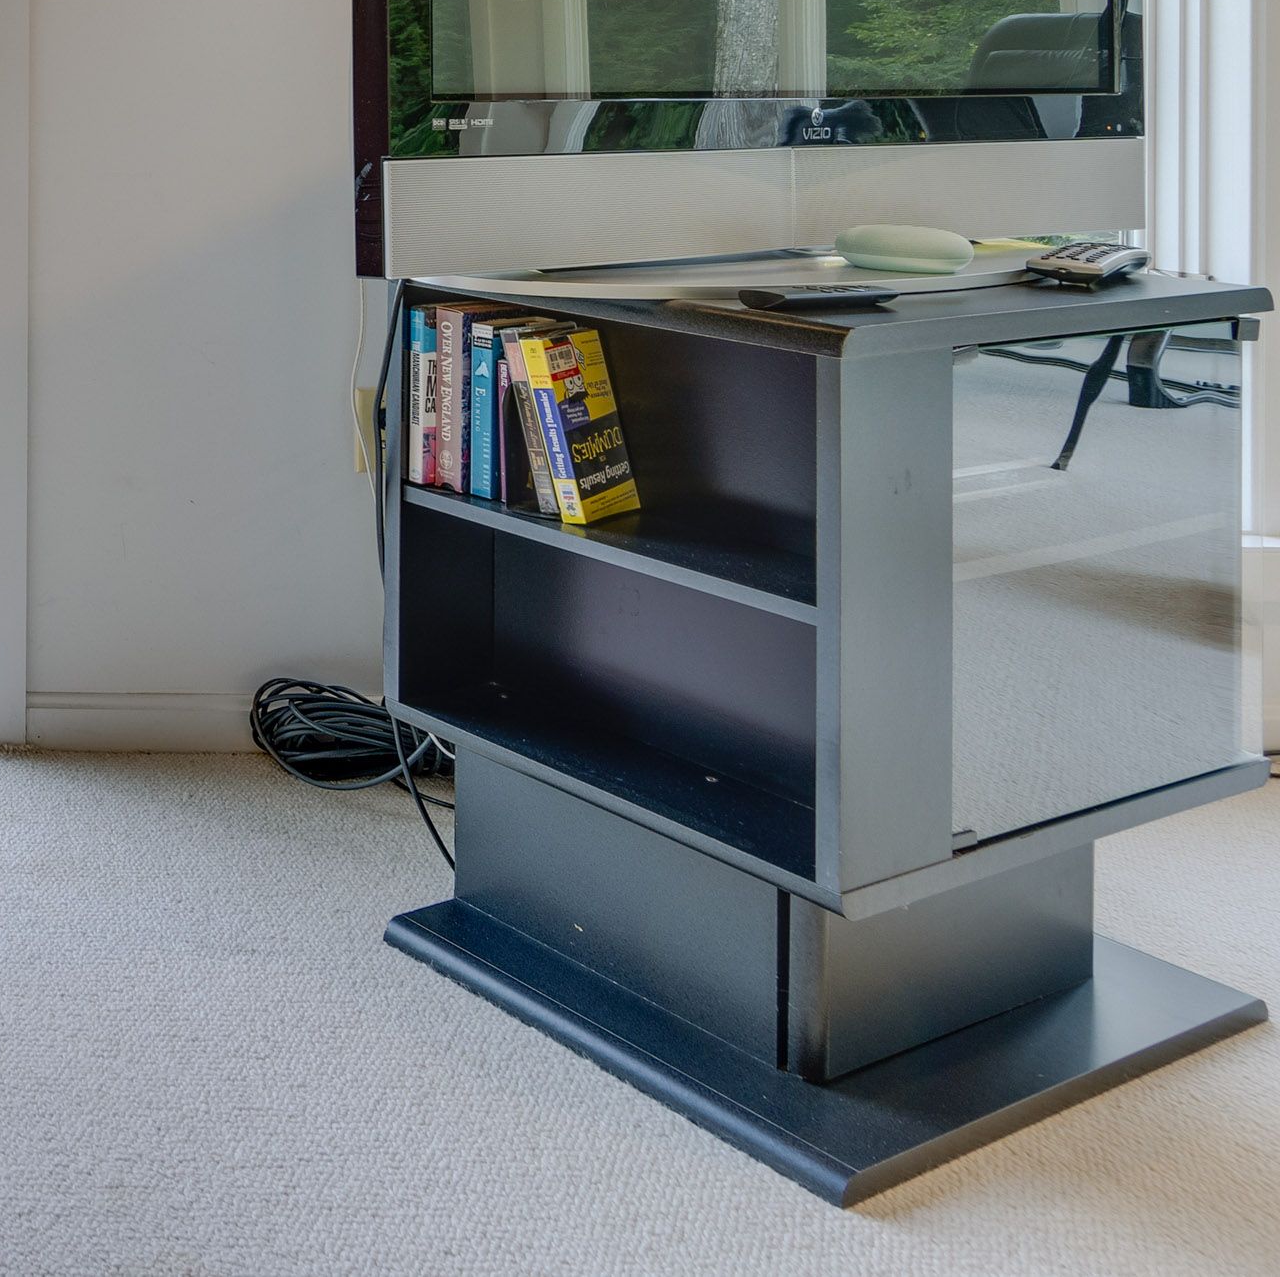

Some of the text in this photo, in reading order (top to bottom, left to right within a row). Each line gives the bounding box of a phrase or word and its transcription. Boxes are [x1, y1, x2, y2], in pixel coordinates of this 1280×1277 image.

[802, 127, 831, 140] VIZIO
[411, 352, 421, 392] MANCHURIAN
[440, 321, 454, 442] OVER NEW ENGLAND
[499, 364, 509, 388] BERLITZ
[411, 394, 421, 426] CANDIDATE
[474, 387, 487, 432] EVENING
[548, 429, 561, 453] Results
[571, 426, 623, 462] DUMMIES
[555, 453, 568, 479] Getting
[580, 461, 630, 491] Getting Results
